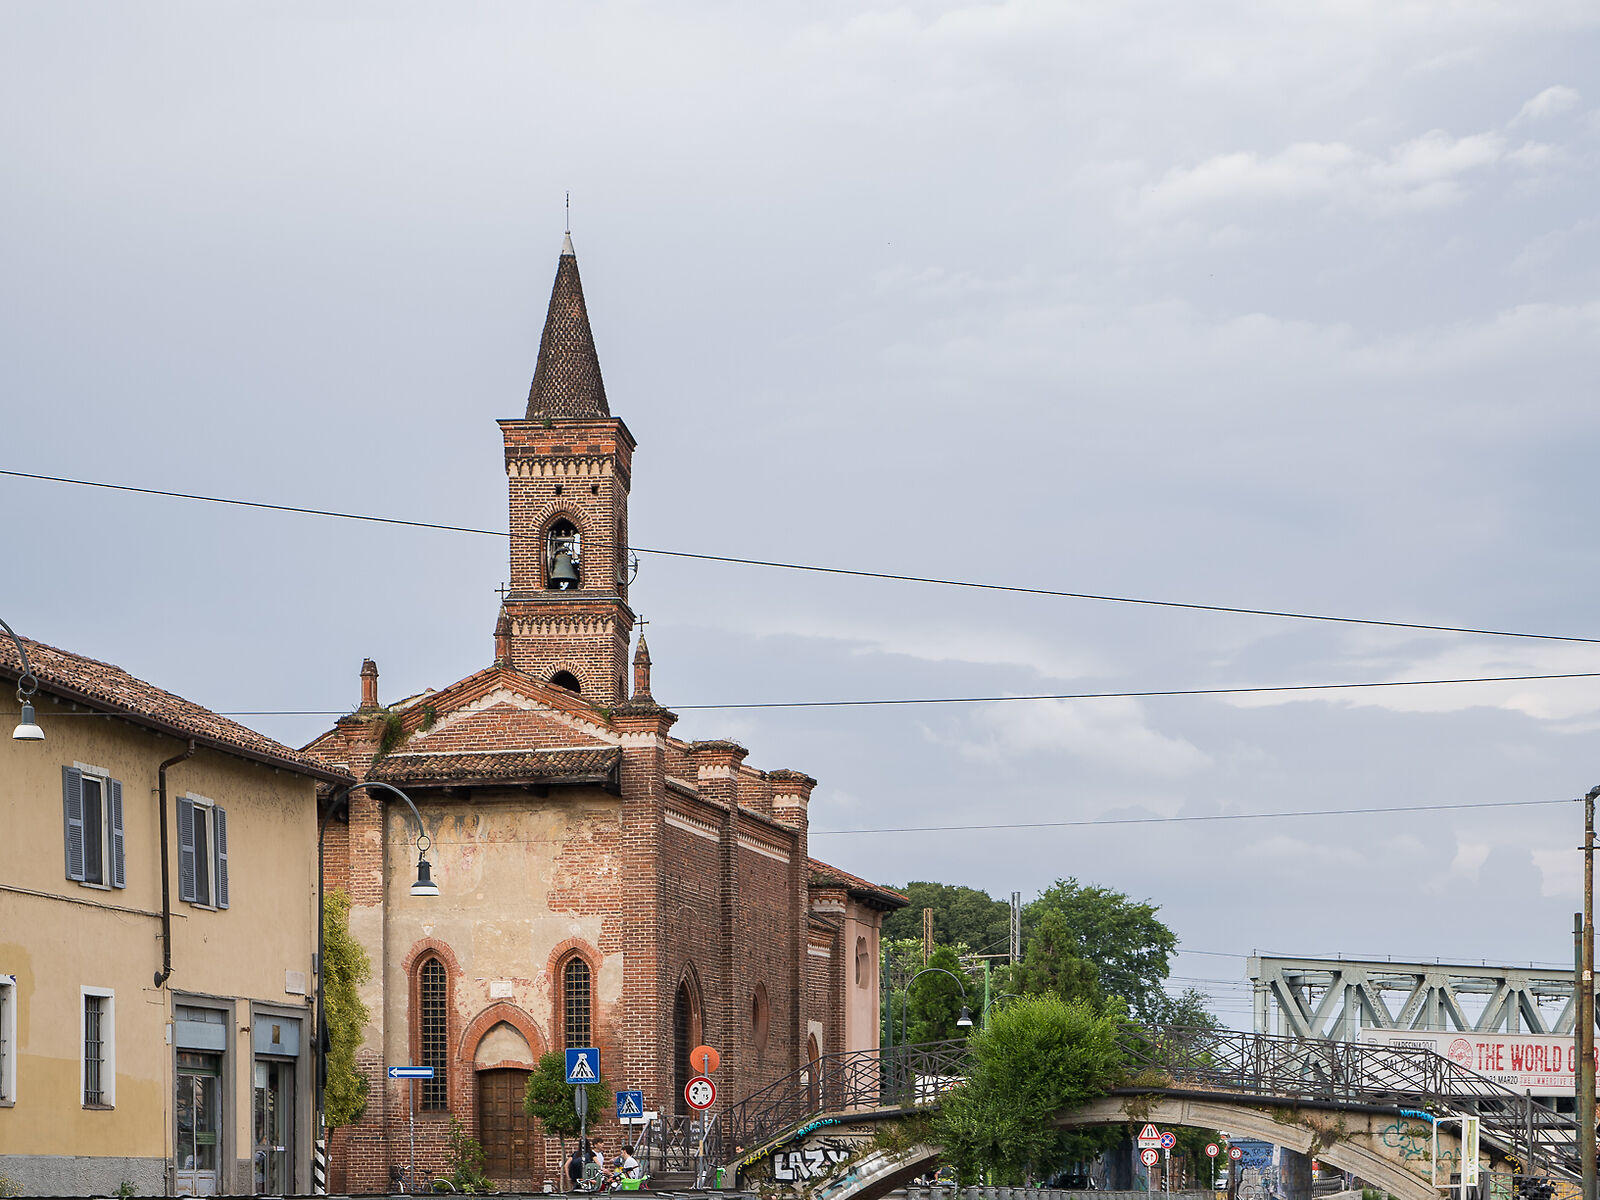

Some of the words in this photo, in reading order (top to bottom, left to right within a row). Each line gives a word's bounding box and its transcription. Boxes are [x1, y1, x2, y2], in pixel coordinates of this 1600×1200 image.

[1476, 1043, 1505, 1071] THE
[1510, 1044, 1562, 1073] WORLD
[1568, 1045, 1576, 1073] O
